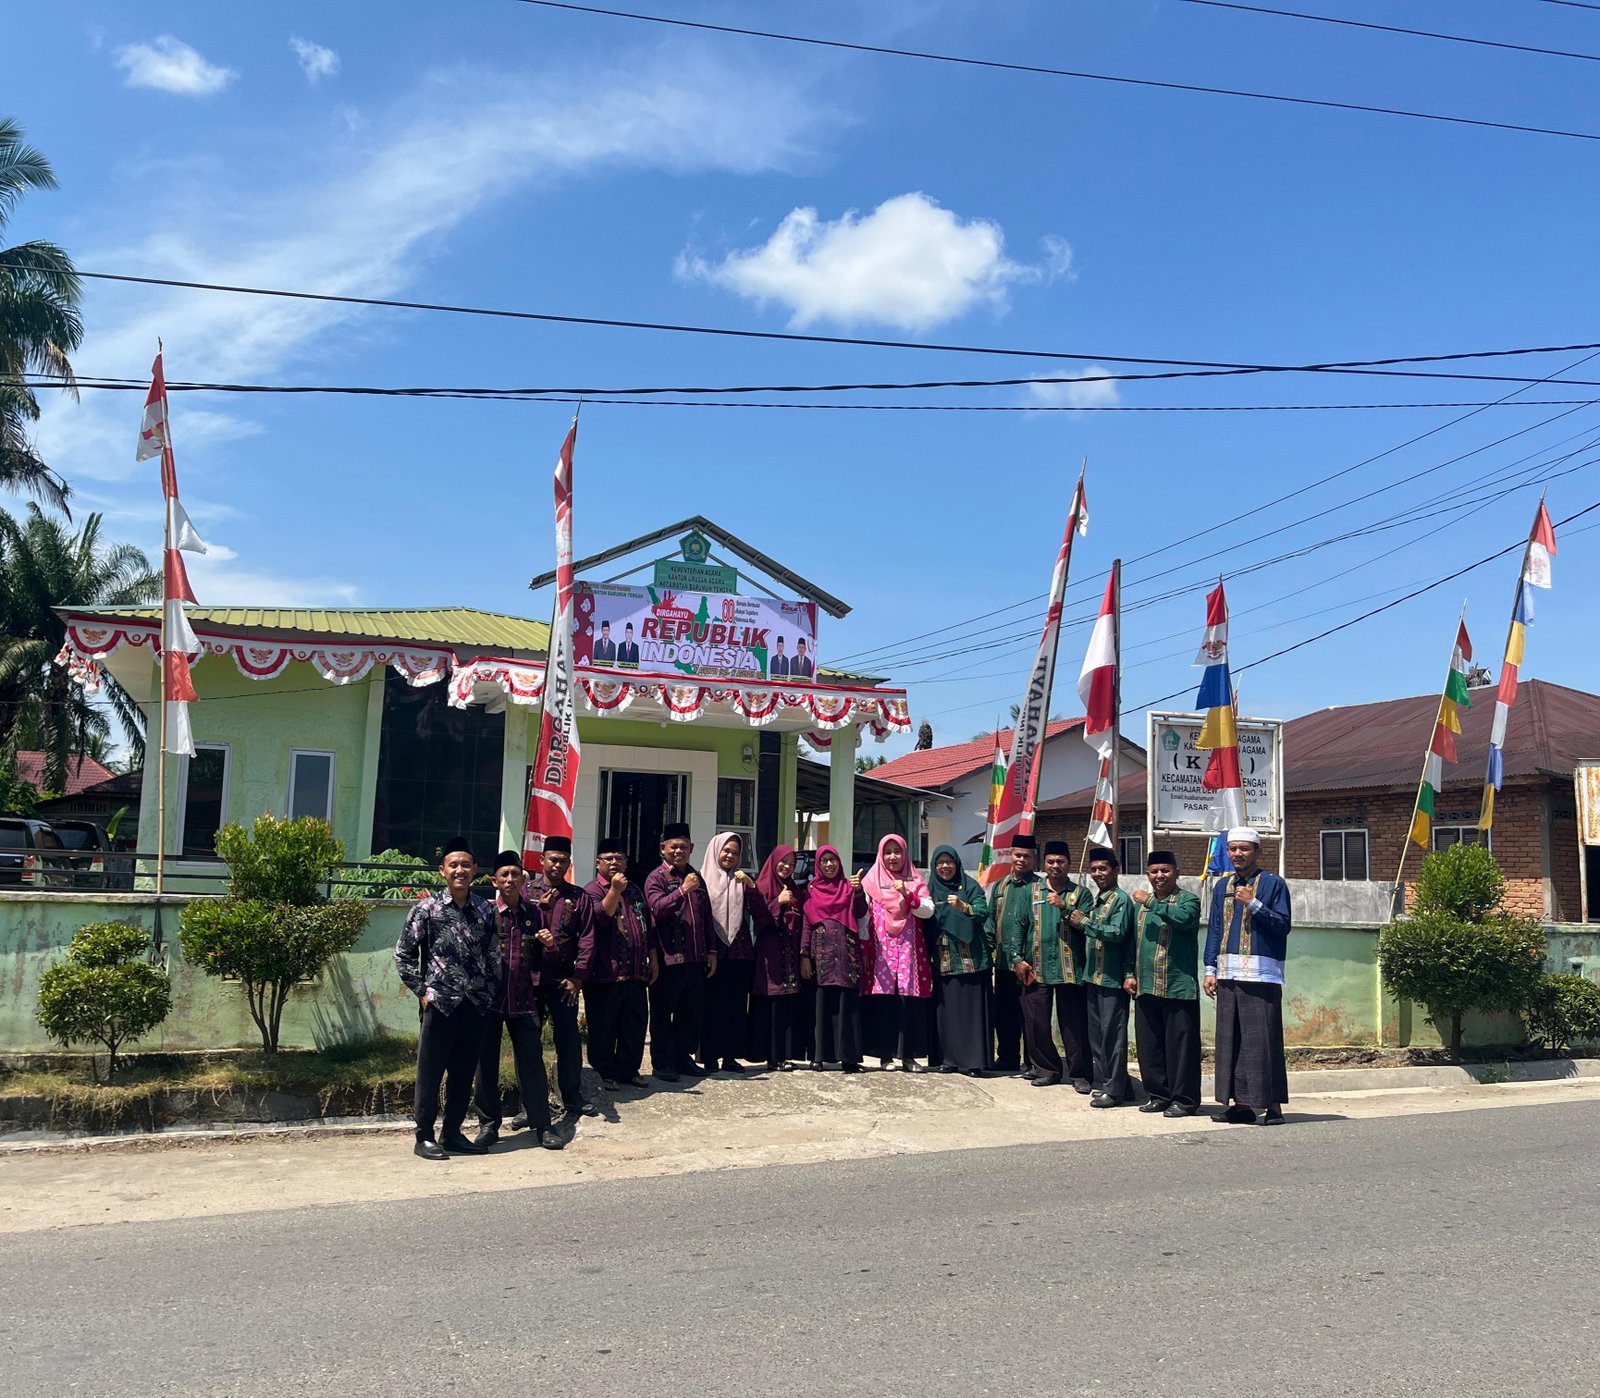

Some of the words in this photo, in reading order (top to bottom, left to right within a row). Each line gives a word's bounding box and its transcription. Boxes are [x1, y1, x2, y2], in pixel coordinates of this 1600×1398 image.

[671, 567, 704, 576] KEMENTERIAN
[660, 581, 688, 589] KECAMATAN
[656, 608, 689, 619] DIRGAHAYU
[641, 617, 770, 648] REPUBLIK
[640, 641, 757, 670] INDONESIA
[1242, 745, 1266, 755] AGAMA
[1161, 773, 1202, 785] KECAMATAN
[1243, 777, 1267, 788] ENGAH
[1172, 785, 1201, 794] KIHAJAR
[1184, 803, 1209, 811] PASAR
